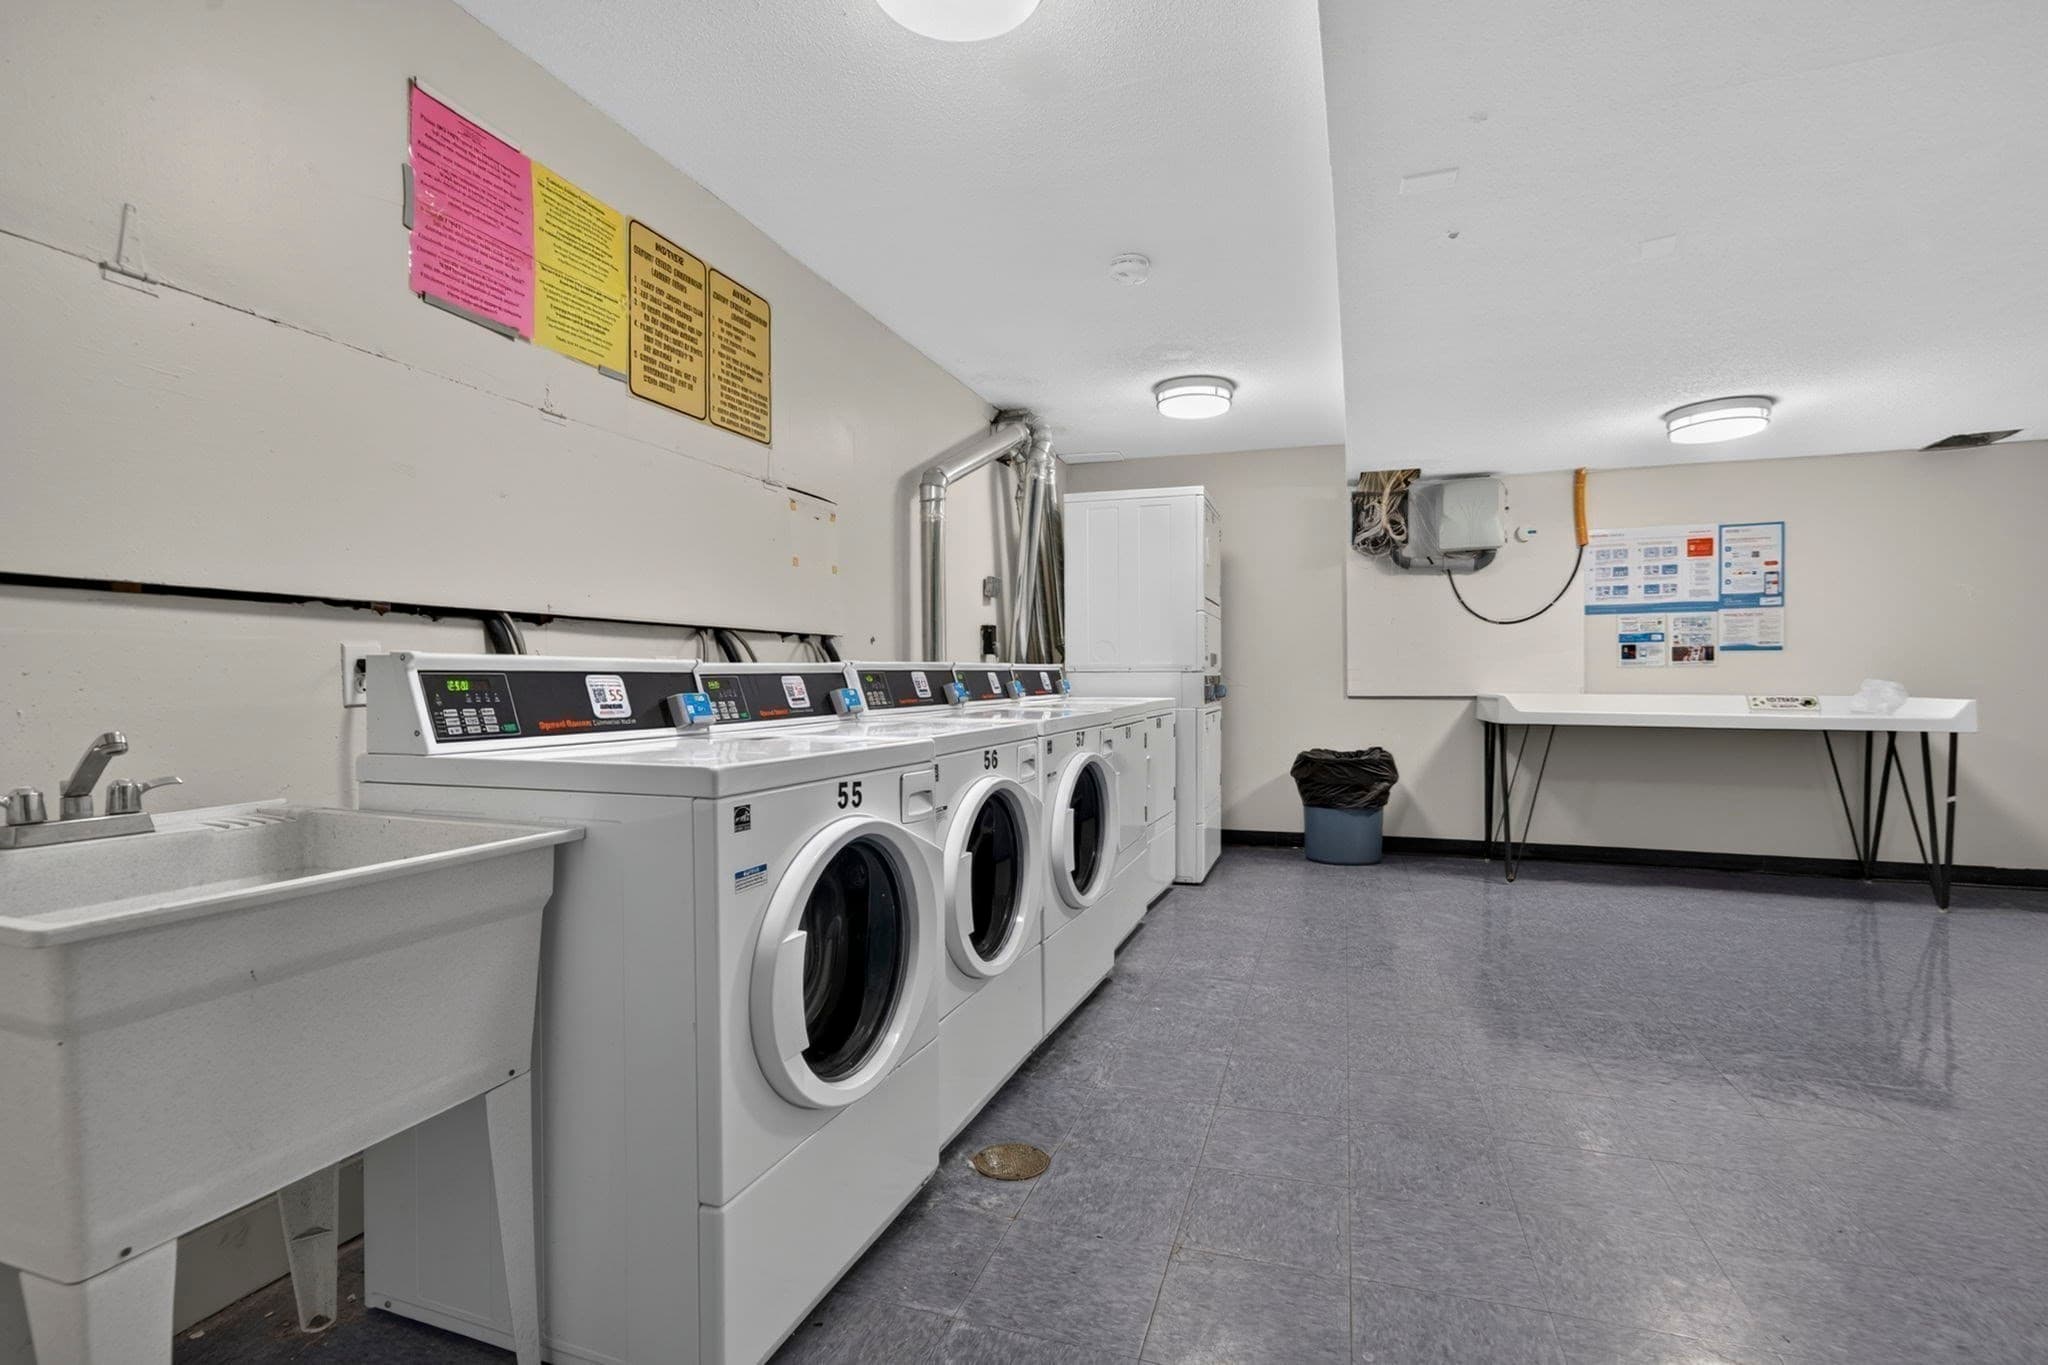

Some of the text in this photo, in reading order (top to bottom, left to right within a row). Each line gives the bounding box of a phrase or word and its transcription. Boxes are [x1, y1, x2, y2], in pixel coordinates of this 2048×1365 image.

[655, 242, 684, 266] NOTICE
[608, 688, 624, 702] 55
[1075, 731, 1086, 748] 57
[983, 749, 999, 770] 56
[837, 780, 863, 809] 55
